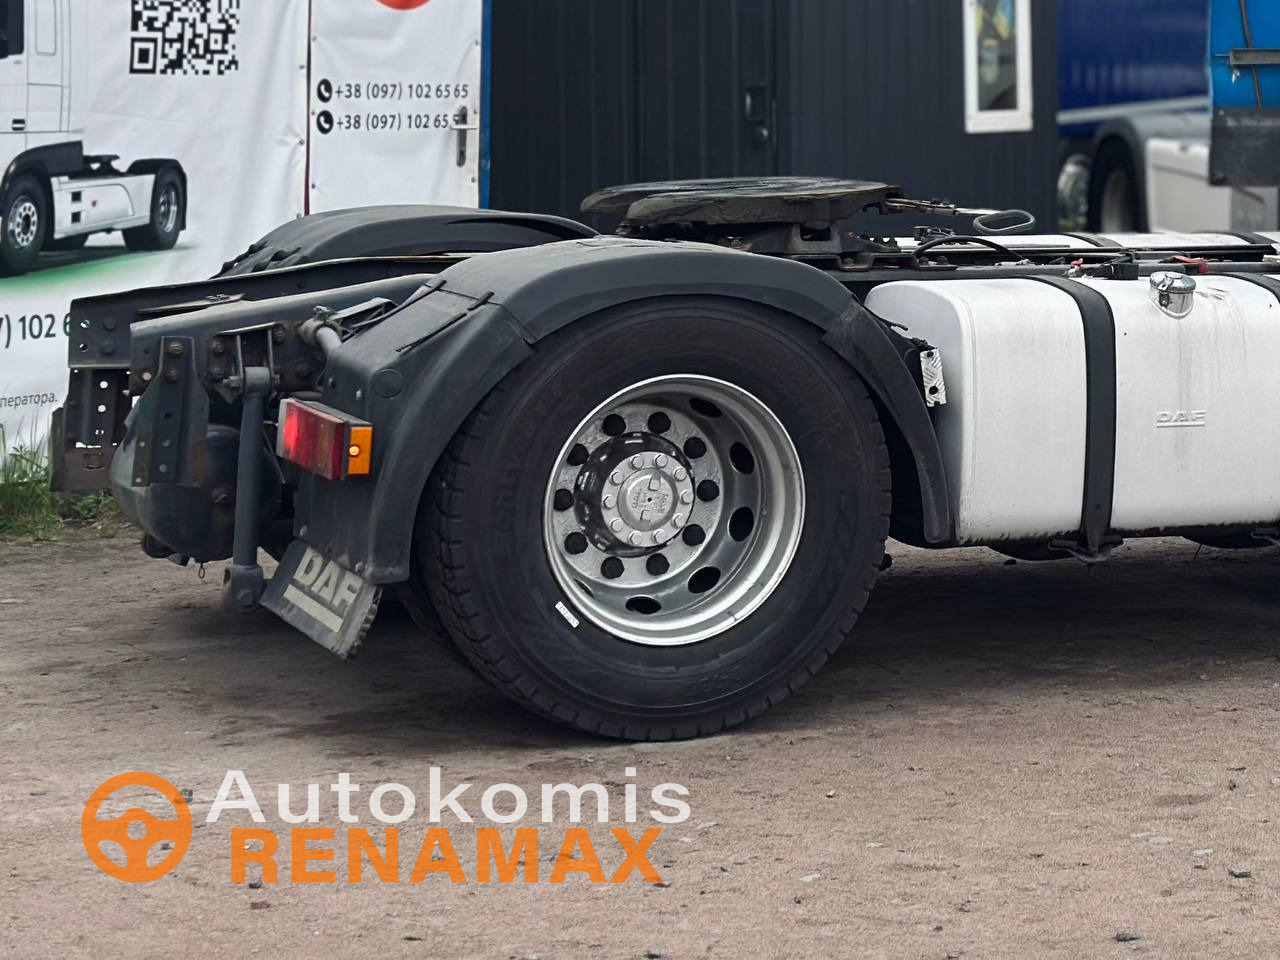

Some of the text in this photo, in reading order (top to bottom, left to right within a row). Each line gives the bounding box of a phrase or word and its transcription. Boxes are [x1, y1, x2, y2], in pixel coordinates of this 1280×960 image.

[335, 82, 469, 100] +38 (097) 102 65 65
[336, 114, 361, 130] +38
[366, 112, 402, 131] (097)
[407, 114, 430, 129] 102
[433, 114, 449, 128] 65
[18, 313, 56, 340] 102
[1156, 410, 1206, 423] DAF
[293, 546, 364, 608] DAF
